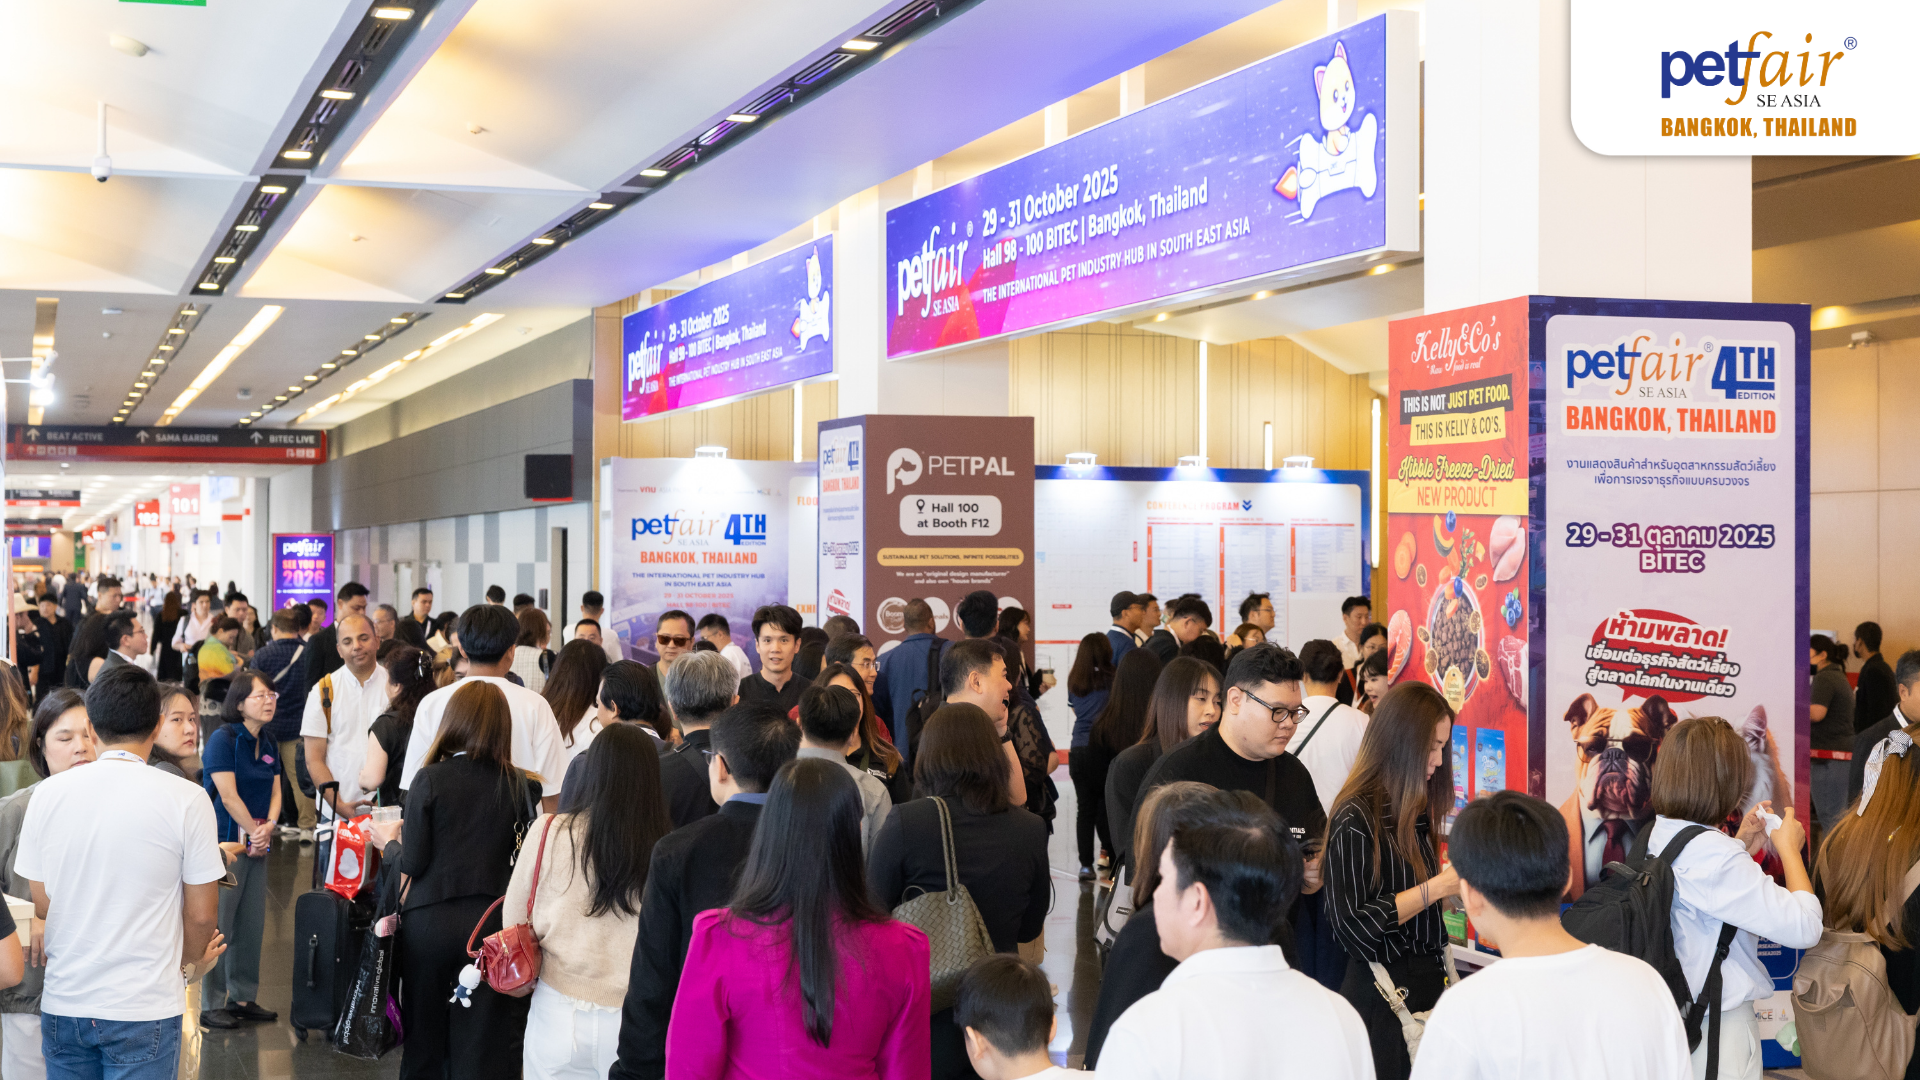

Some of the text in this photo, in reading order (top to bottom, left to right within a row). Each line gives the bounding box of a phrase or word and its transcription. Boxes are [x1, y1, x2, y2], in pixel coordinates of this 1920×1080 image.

[982, 207, 997, 237] 29
[1008, 199, 1021, 228] 31
[1024, 183, 1079, 222] October
[1082, 164, 1118, 203] 2025
[983, 242, 1002, 269] Hall
[1004, 239, 1017, 263] 98
[1026, 231, 1044, 256] 100
[1046, 219, 1079, 250] BITEC
[1088, 199, 1146, 237] Bangkok,
[1149, 176, 1208, 219] Thailand
[897, 222, 968, 318] petfair
[982, 216, 1251, 304] THE INTERNATIONAL PET INDUSTRY HUB IN SOUTH EAST ASIA
[932, 295, 960, 317] SE ASIA
[669, 303, 730, 342] 29 31 October 2025
[715, 327, 741, 351] Bangkok,
[741, 318, 767, 342] Thailand
[760, 348, 772, 363] EAST
[772, 346, 783, 359] ASIA
[1566, 335, 1776, 400] petfair 4TH
[1403, 383, 1511, 413] THIS IS NOT JUST PET FOOD.
[1639, 386, 1776, 400] SE ASIA EDITION
[1415, 422, 1434, 440] THIS
[1435, 421, 1443, 439] IS
[1445, 418, 1469, 438] KELLY
[1471, 418, 1477, 435] &
[1566, 405, 1776, 434] BANGKOK, THAILAND
[72, 432, 104, 442] ACTIVE
[155, 433, 219, 443] SAMA GARDEN
[269, 434, 316, 444] BITEC LIVE
[928, 456, 1016, 476] PETPAL
[1398, 454, 1515, 486] Kibble Freeze-Dried
[171, 497, 199, 513] 101
[932, 502, 979, 513] Hall 100
[1200, 501, 1240, 511] PROGRAM
[1417, 486, 1497, 508] NEW PRODUCT
[137, 512, 160, 526] 102
[724, 514, 766, 546] 4TH
[917, 518, 990, 528] at Booth F12
[1567, 524, 1774, 550] 29 31 ตุลาคม 2025
[297, 559, 315, 570] YOU
[640, 551, 758, 565] BANGKOK, THAILAND
[1641, 551, 1705, 571] BITEC
[282, 569, 326, 588] 2026
[949, 570, 969, 578] design
[1608, 611, 1729, 649] ห้ามพลาด!
[1586, 640, 1740, 676] เชื่อมต่อธุรกิจสัตว์เลี้ยง
[1586, 666, 1736, 696] สู่ตลาดโลกในงานเดียว
[369, 949, 385, 1014] innovative.global
